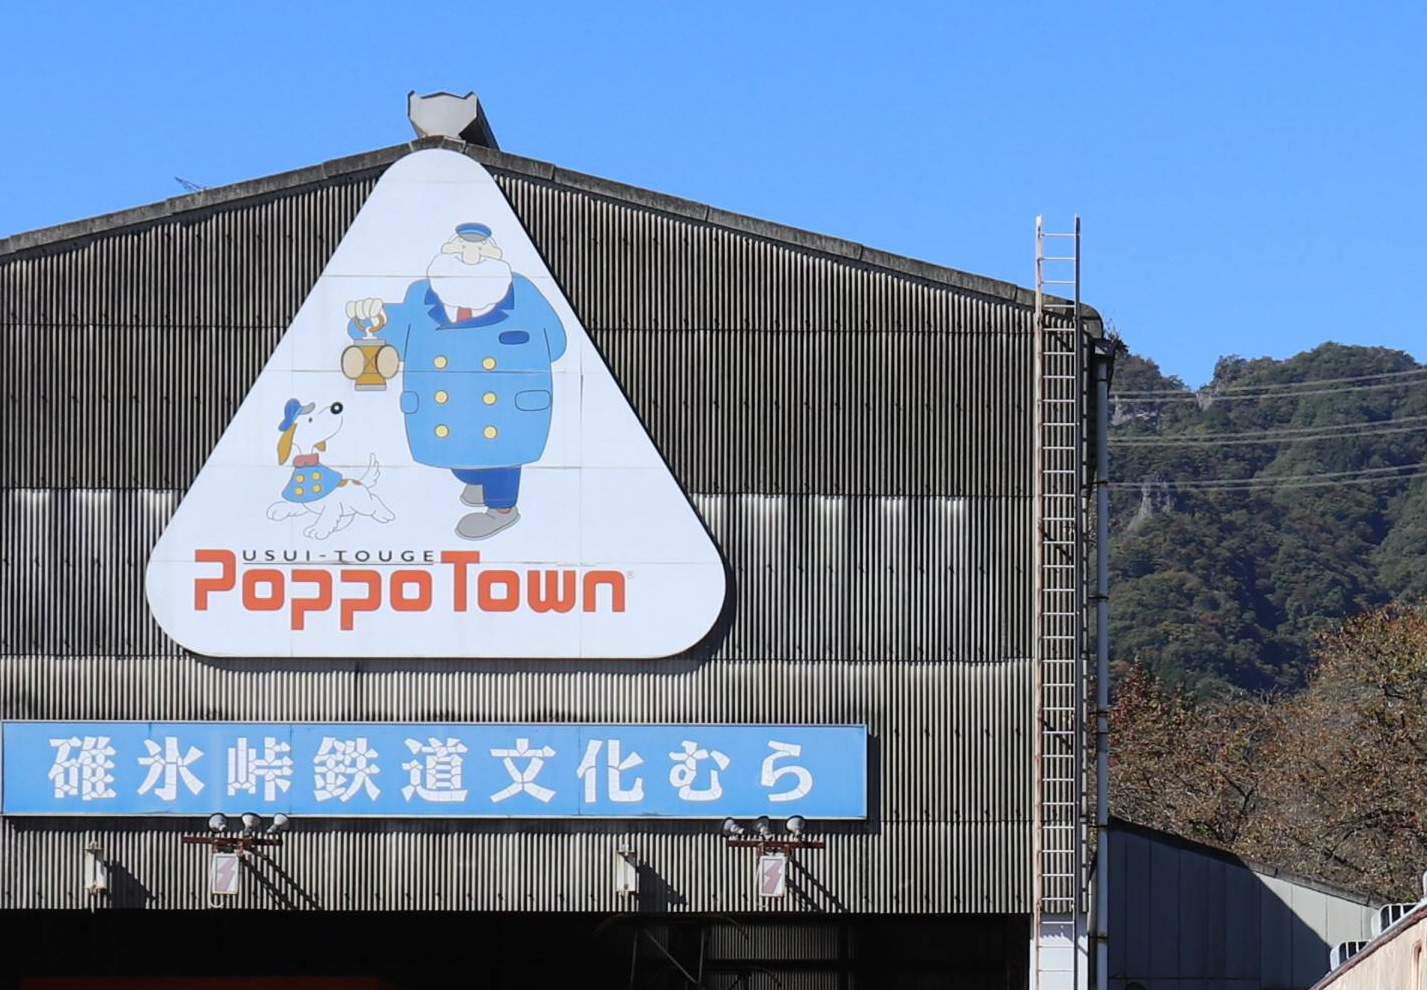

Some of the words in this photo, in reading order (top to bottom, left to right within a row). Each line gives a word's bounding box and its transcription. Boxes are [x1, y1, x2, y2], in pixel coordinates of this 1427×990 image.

[242, 549, 434, 562] USUI-TOUGE
[48, 736, 815, 803] 碓氷峠鉄道文化むら
